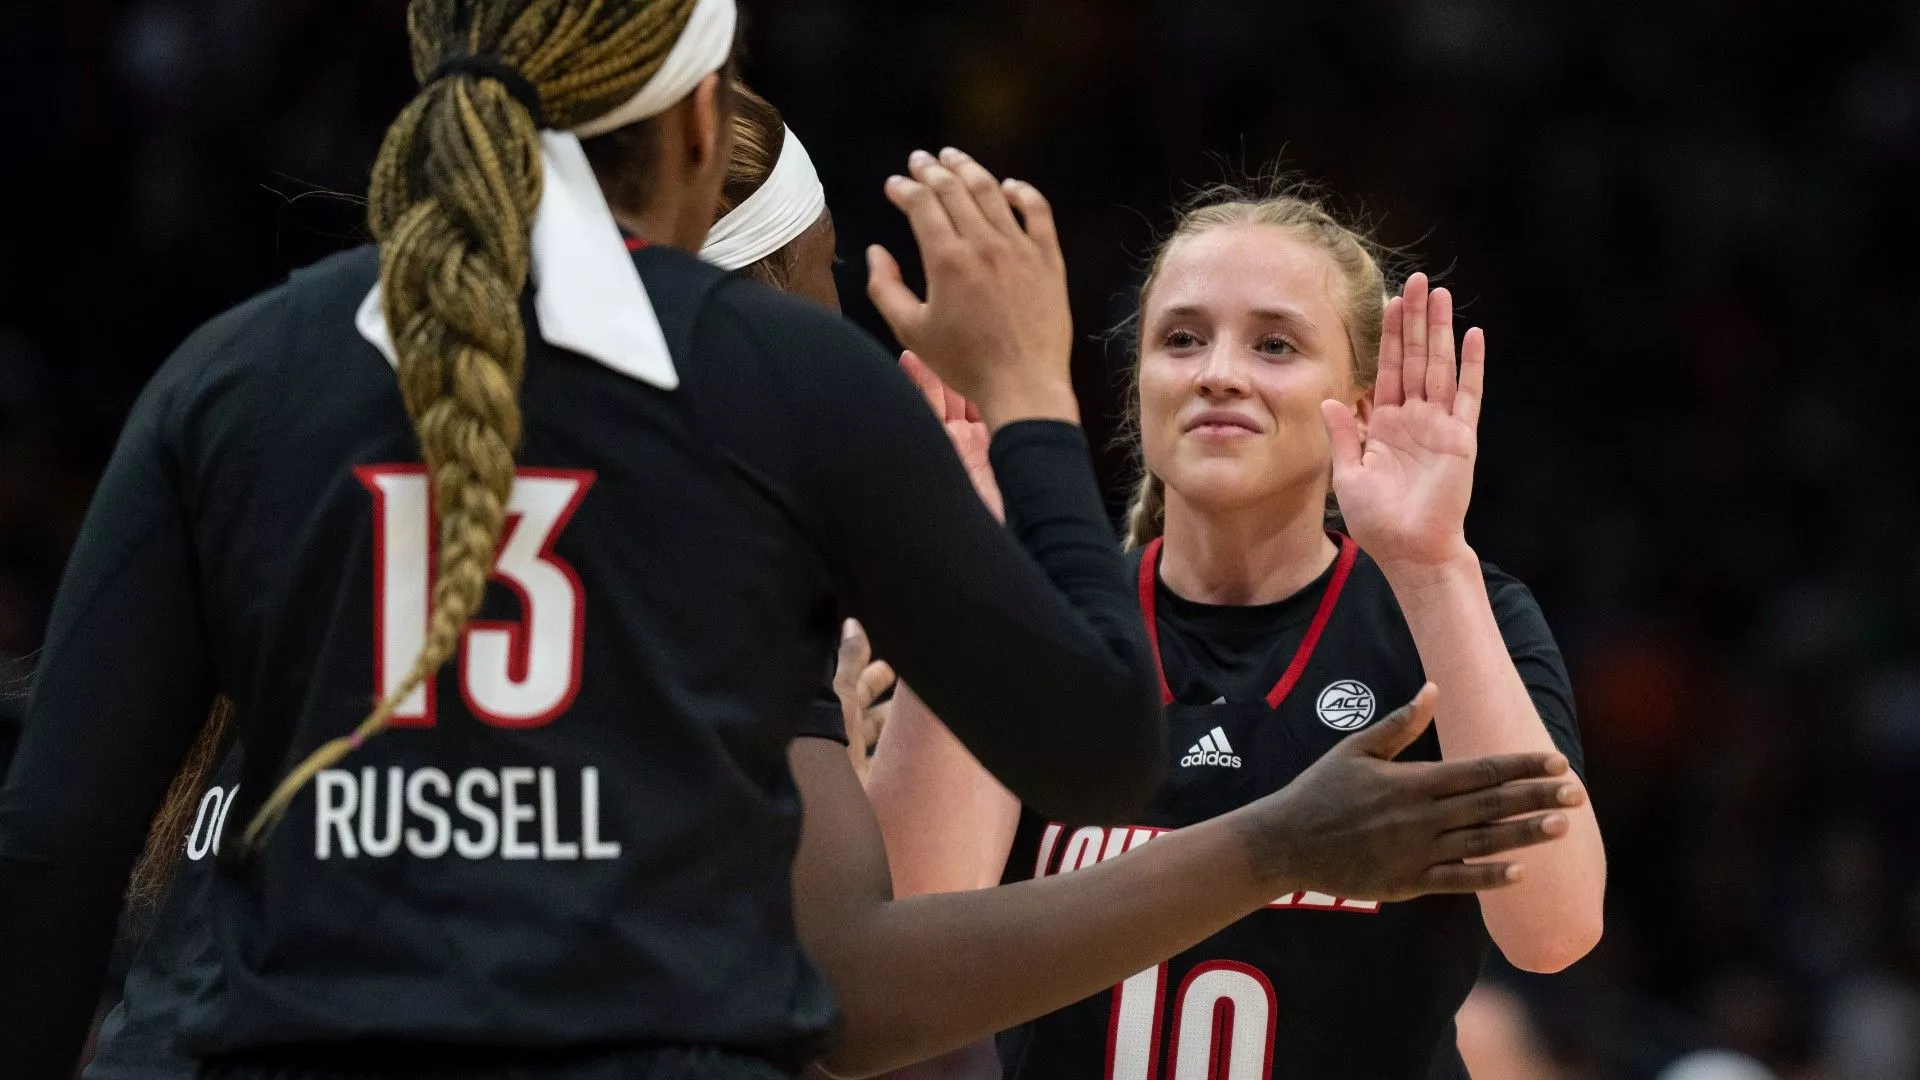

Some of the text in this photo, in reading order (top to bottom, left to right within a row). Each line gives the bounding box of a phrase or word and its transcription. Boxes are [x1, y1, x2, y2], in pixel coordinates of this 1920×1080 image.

[353, 464, 597, 728] 13
[1325, 696, 1371, 709] ACC
[1180, 750, 1242, 768] adidas
[315, 766, 621, 860] RUSSELL
